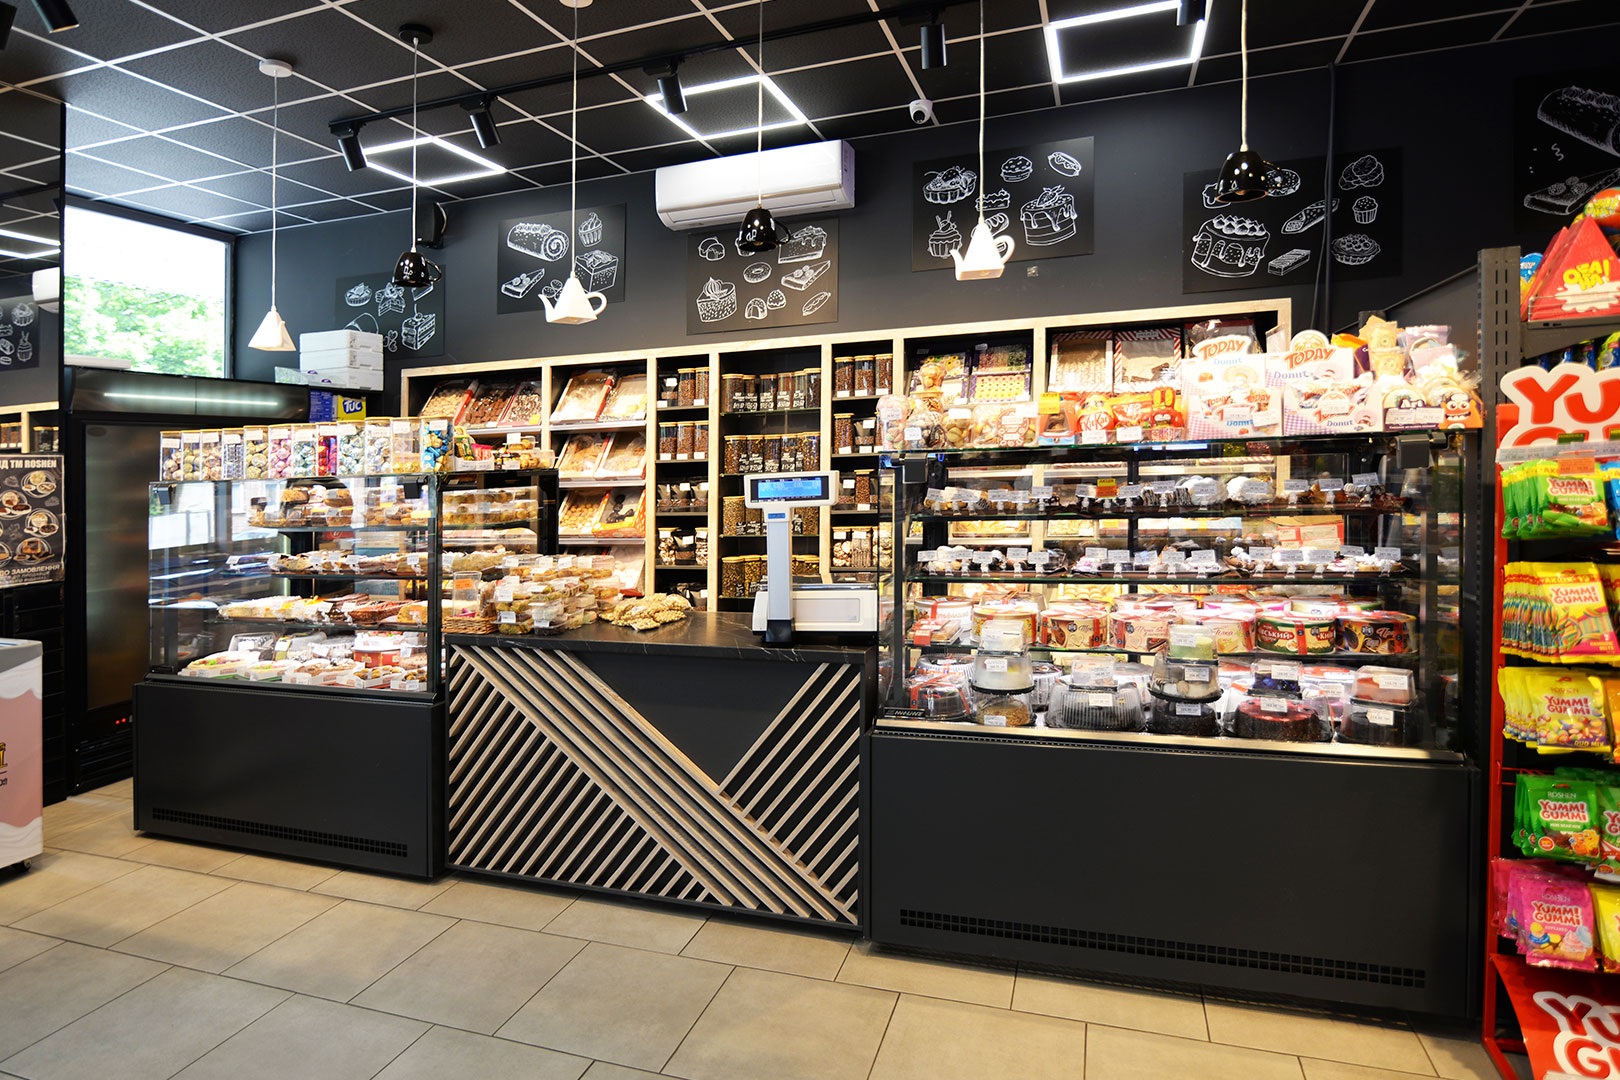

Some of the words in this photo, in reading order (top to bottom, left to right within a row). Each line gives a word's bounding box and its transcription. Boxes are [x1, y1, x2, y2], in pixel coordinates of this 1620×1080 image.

[1199, 339, 1245, 360] TODAY
[1284, 347, 1334, 369] TODAY
[1273, 370, 1307, 380] Donut
[344, 400, 361, 413] TUC
[1083, 411, 1109, 431] KitKat
[1327, 419, 1354, 428] Donut
[0, 459, 9, 470] Д
[24, 459, 57, 469] ROSHEN
